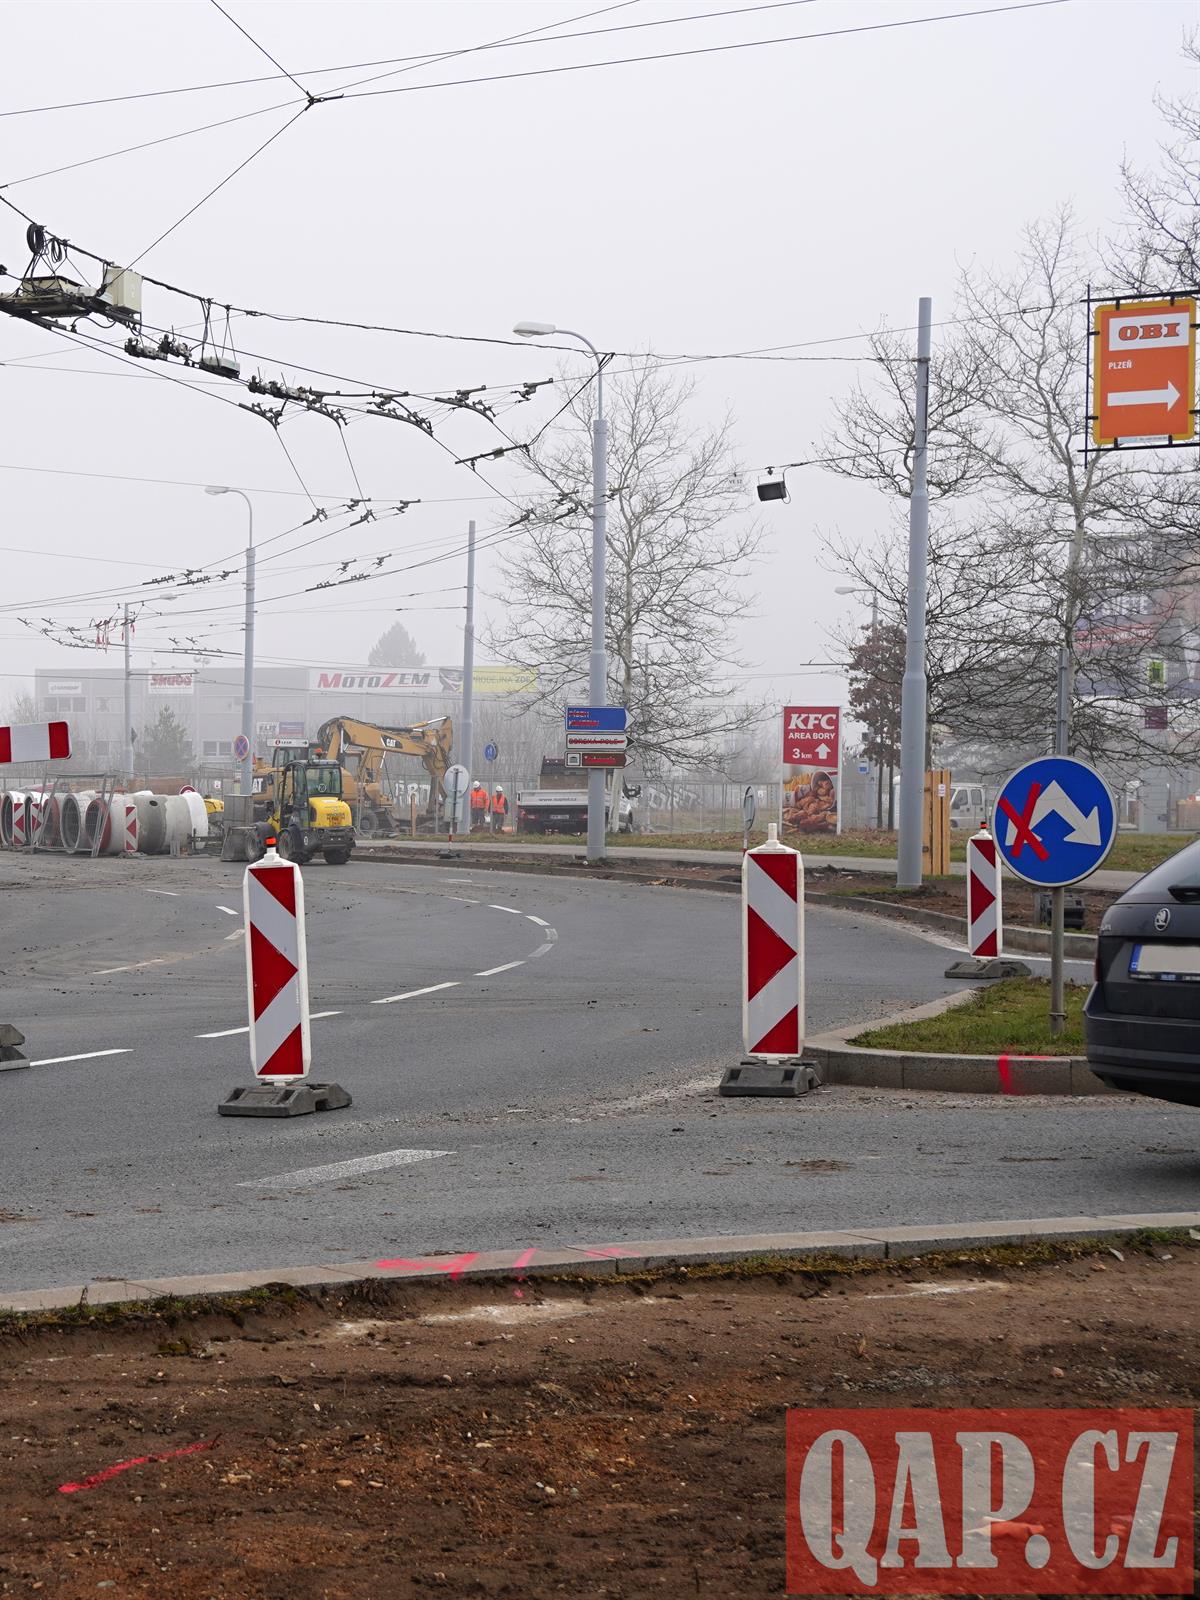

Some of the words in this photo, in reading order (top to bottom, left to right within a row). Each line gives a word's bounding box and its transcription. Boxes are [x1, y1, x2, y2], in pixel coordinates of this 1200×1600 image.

[1118, 322, 1181, 341] OBI
[1108, 359, 1133, 370] PLZEŇ
[788, 713, 837, 730] KFC
[788, 732, 812, 740] AREA
[813, 732, 836, 740] BORY
[386, 738, 396, 748] CAT
[792, 747, 801, 759] 3
[251, 777, 264, 794] AT
